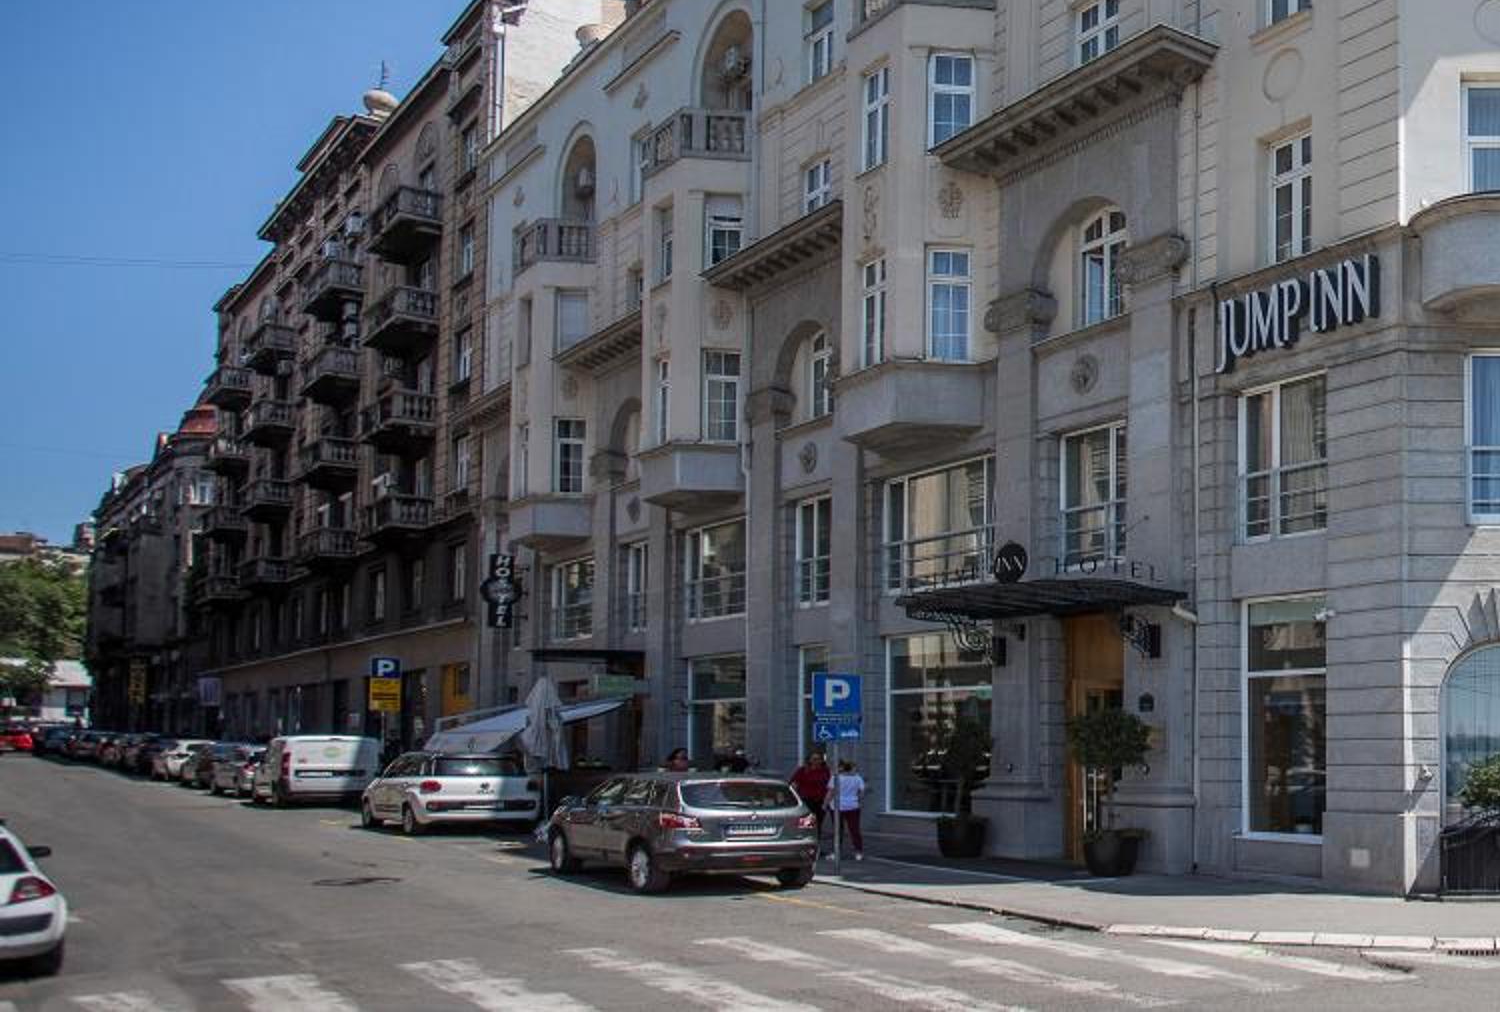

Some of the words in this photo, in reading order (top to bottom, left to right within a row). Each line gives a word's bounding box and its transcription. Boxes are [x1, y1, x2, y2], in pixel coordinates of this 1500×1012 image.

[1215, 278, 1301, 373] JUMP
[1309, 253, 1371, 333] INN
[377, 659, 395, 677] P
[825, 679, 851, 707] P
